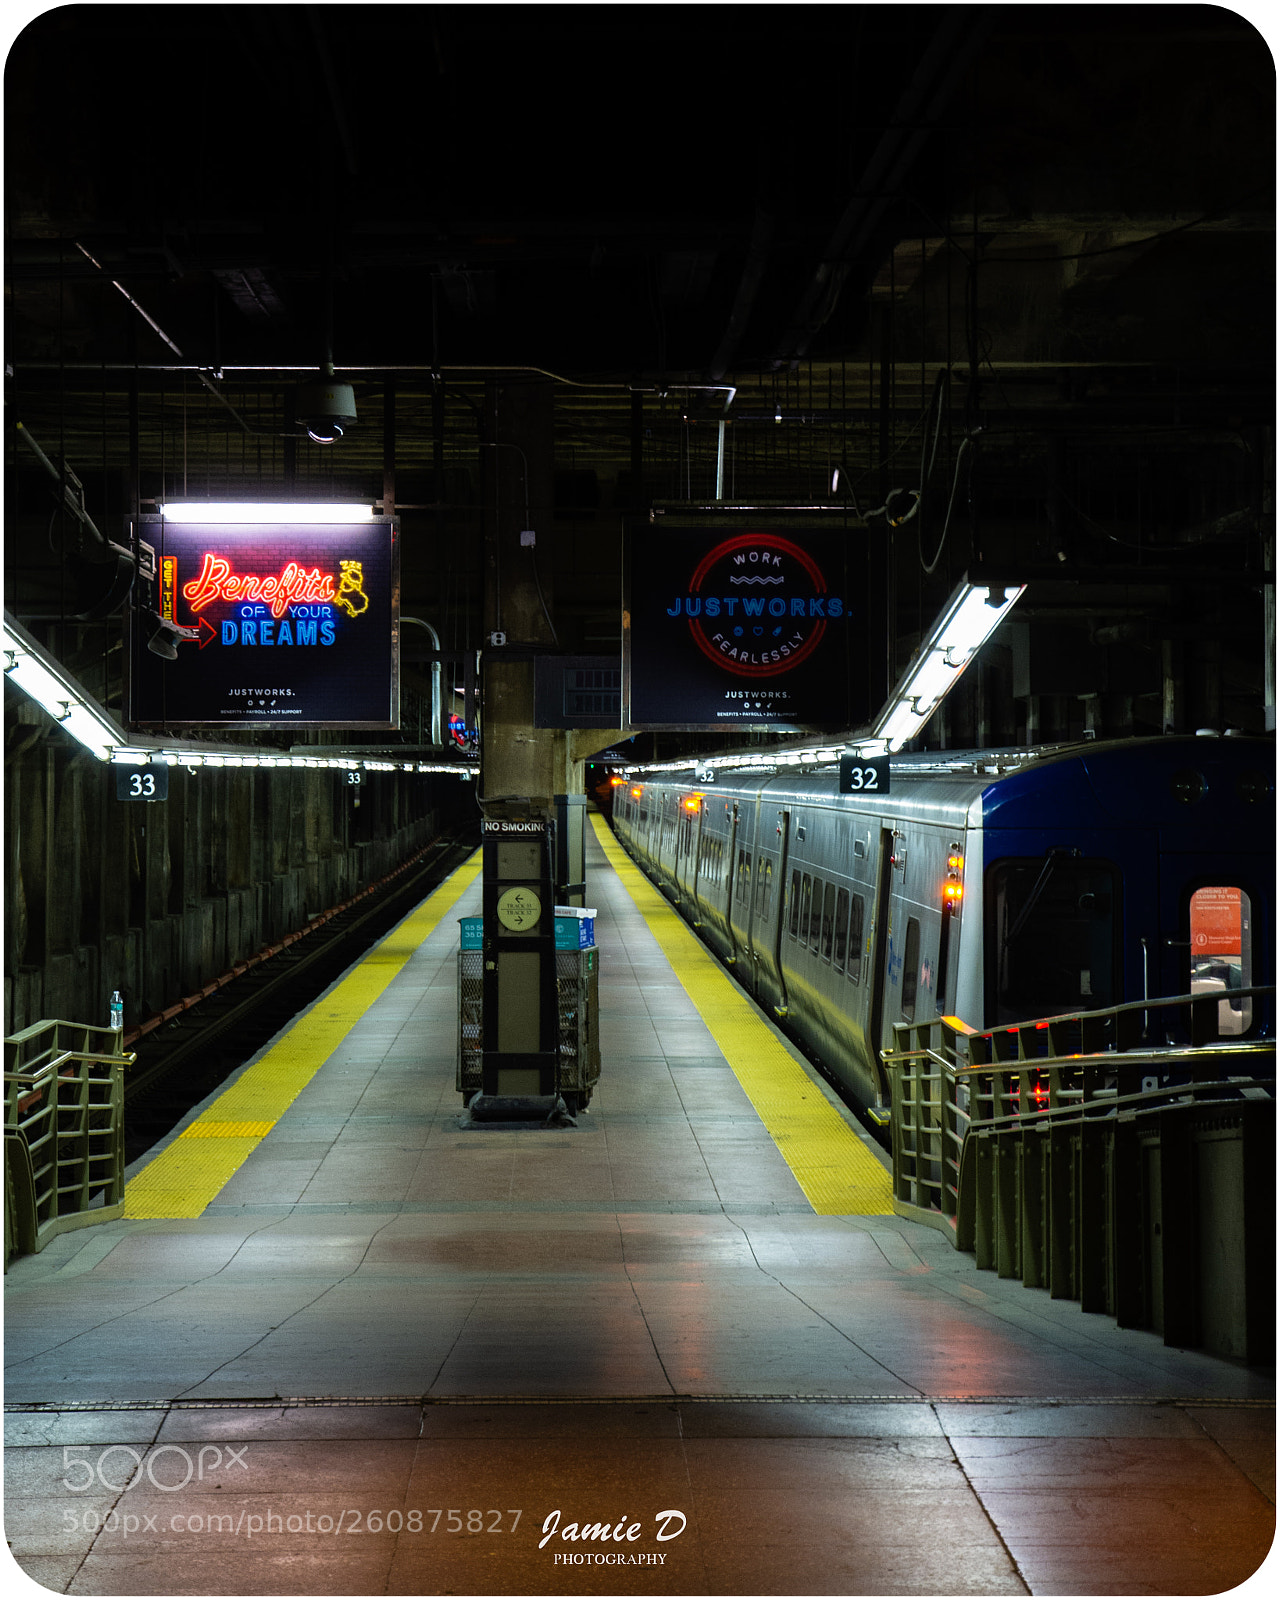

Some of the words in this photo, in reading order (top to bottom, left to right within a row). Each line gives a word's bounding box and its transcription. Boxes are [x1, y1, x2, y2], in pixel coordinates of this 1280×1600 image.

[733, 552, 782, 566] WORK
[163, 560, 172, 588] GET
[183, 554, 335, 618] Benefits
[163, 592, 172, 620] THE
[241, 606, 265, 618] OF
[289, 606, 331, 618] YOUR
[667, 598, 853, 617] JUSTWORKS.
[222, 620, 336, 646] DREAMS
[712, 632, 804, 664] FEARLESSLY
[228, 688, 296, 696] JUSTWORKS.
[725, 691, 791, 699] JUSTWORKS.
[129, 773, 156, 797] 33
[347, 772, 361, 784] 33
[700, 771, 715, 783] 32
[851, 767, 879, 790] 32
[485, 822, 500, 832] NO
